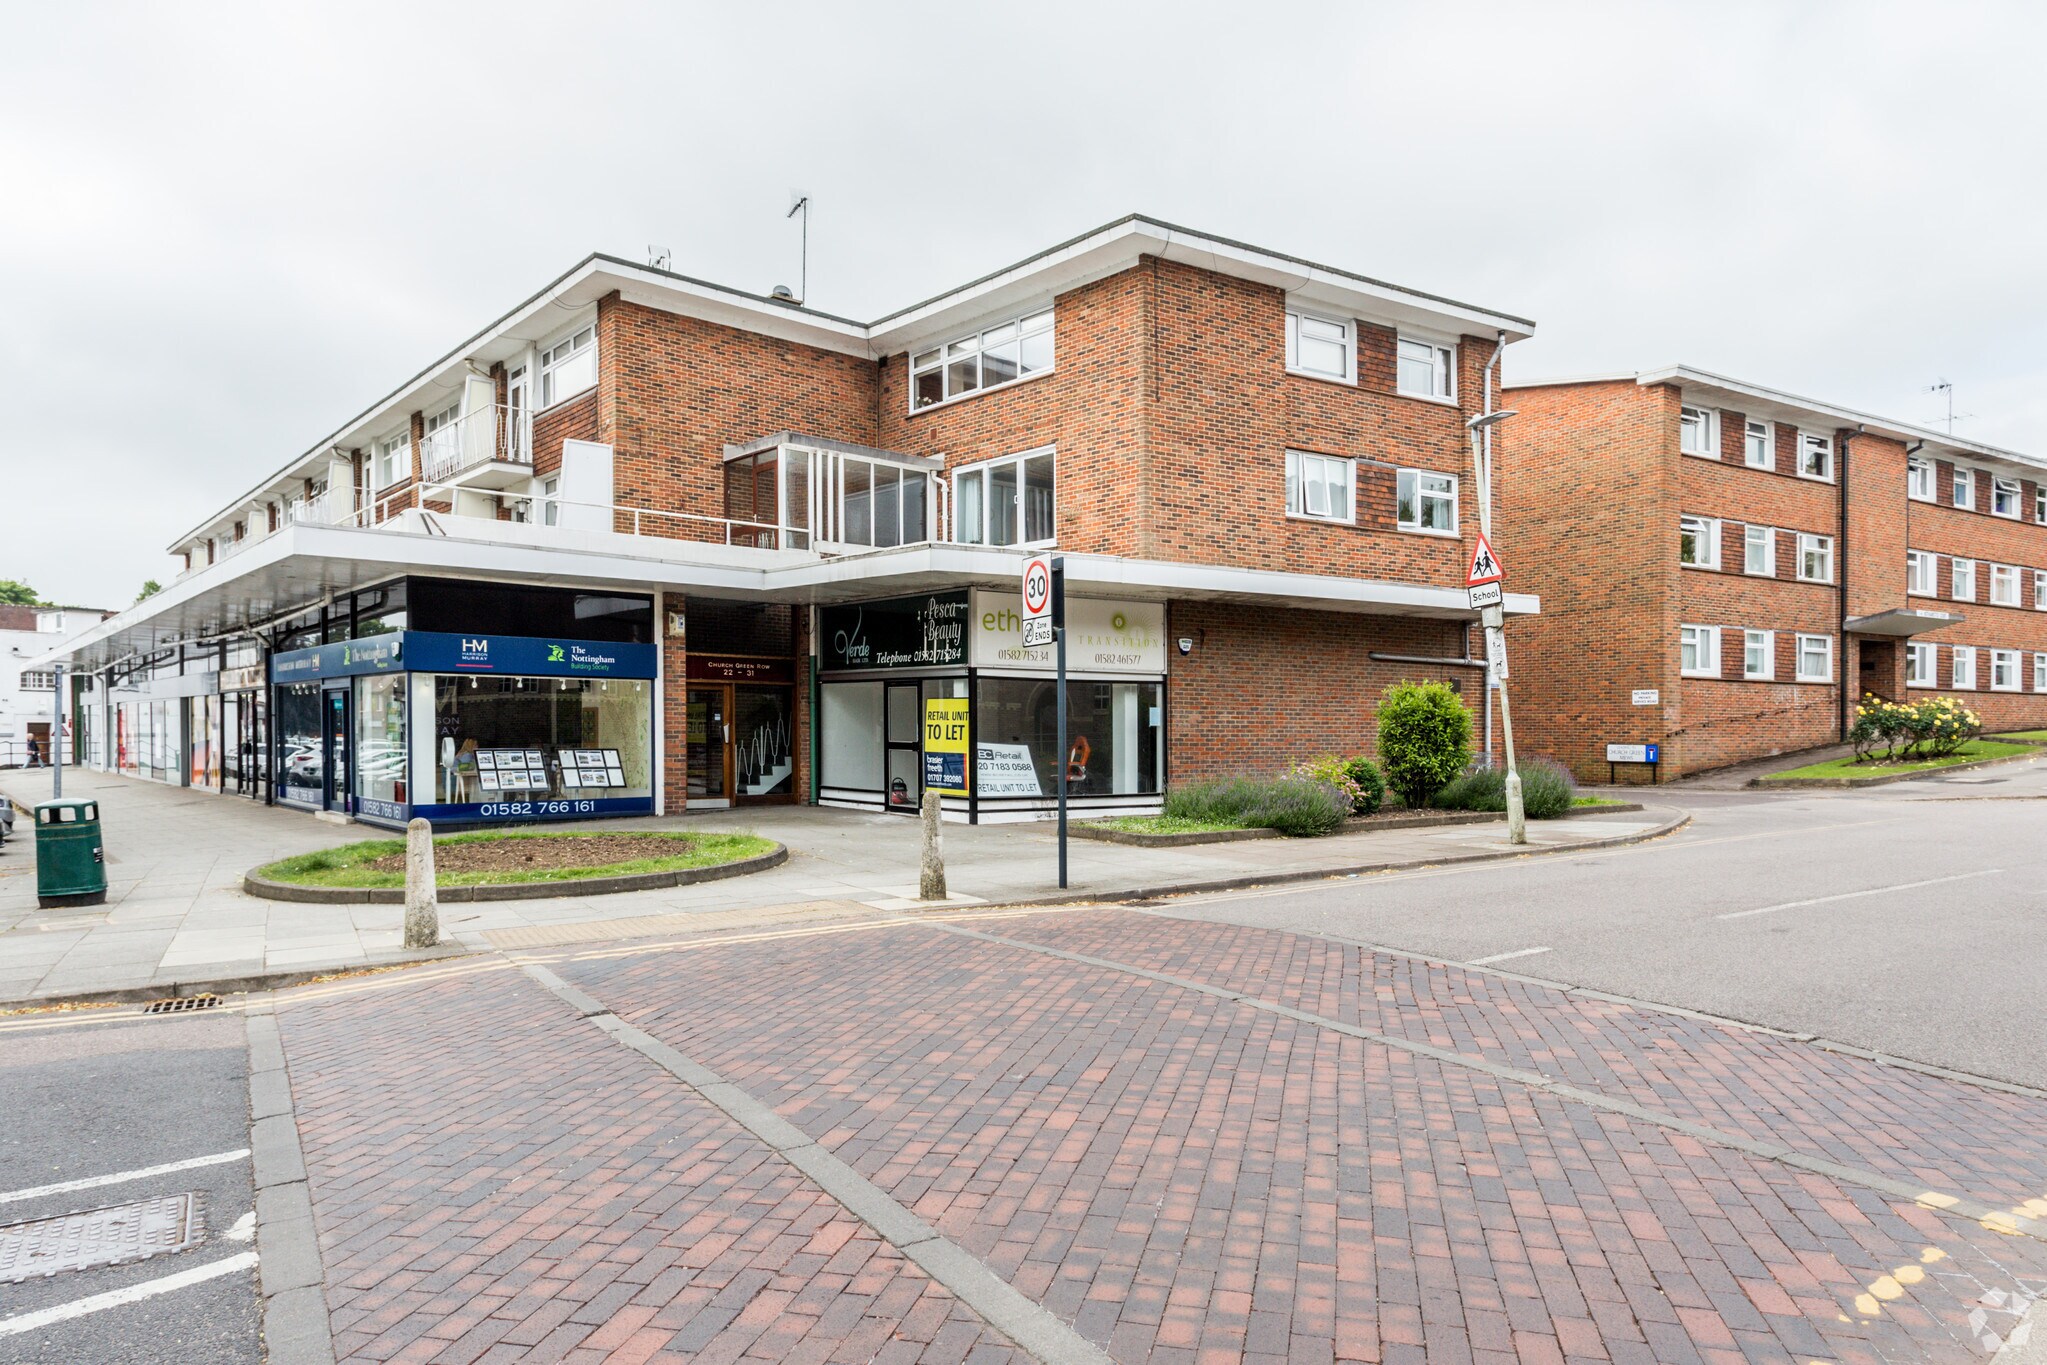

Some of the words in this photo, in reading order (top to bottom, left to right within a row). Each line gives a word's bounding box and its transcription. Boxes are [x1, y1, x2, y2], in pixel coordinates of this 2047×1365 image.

[1028, 575, 1046, 598] 30
[1473, 589, 1499, 601] School
[927, 598, 956, 619] Pesca
[982, 608, 1020, 632] eth
[834, 605, 870, 665] Verde
[927, 619, 962, 645] Beauty
[1035, 630, 1050, 640] ENDS
[462, 639, 488, 653] HM
[1078, 635, 1159, 648] TRANSITION
[571, 646, 586, 654] The
[998, 649, 1021, 661] 01582
[1022, 650, 1049, 662] 715234
[571, 654, 615, 664] Nottingham
[876, 651, 912, 666] Telephone
[914, 650, 934, 662] 01582
[1095, 653, 1116, 664] 01582
[1116, 654, 1141, 665] 461577
[571, 663, 591, 671] Building
[927, 711, 950, 721] RETAIL
[951, 711, 969, 721] UNIT
[927, 724, 942, 740] TO
[945, 724, 965, 740] LET
[926, 755, 943, 764] brasier
[995, 751, 1022, 759] Retail
[926, 764, 943, 772] freeth
[990, 762, 1010, 771] 7183
[1012, 763, 1033, 771] 0588
[927, 773, 942, 782] 01707
[943, 774, 963, 784] 392080
[978, 783, 1000, 792] RETAIL
[1000, 783, 1015, 792] UNIT
[1016, 783, 1025, 792] TO
[1025, 783, 1037, 792] LET
[363, 801, 380, 815] 01582
[380, 803, 392, 817] 766
[393, 806, 401, 819] 161
[481, 802, 532, 816] 01582
[537, 801, 570, 813] 766
[574, 800, 595, 812] 161
